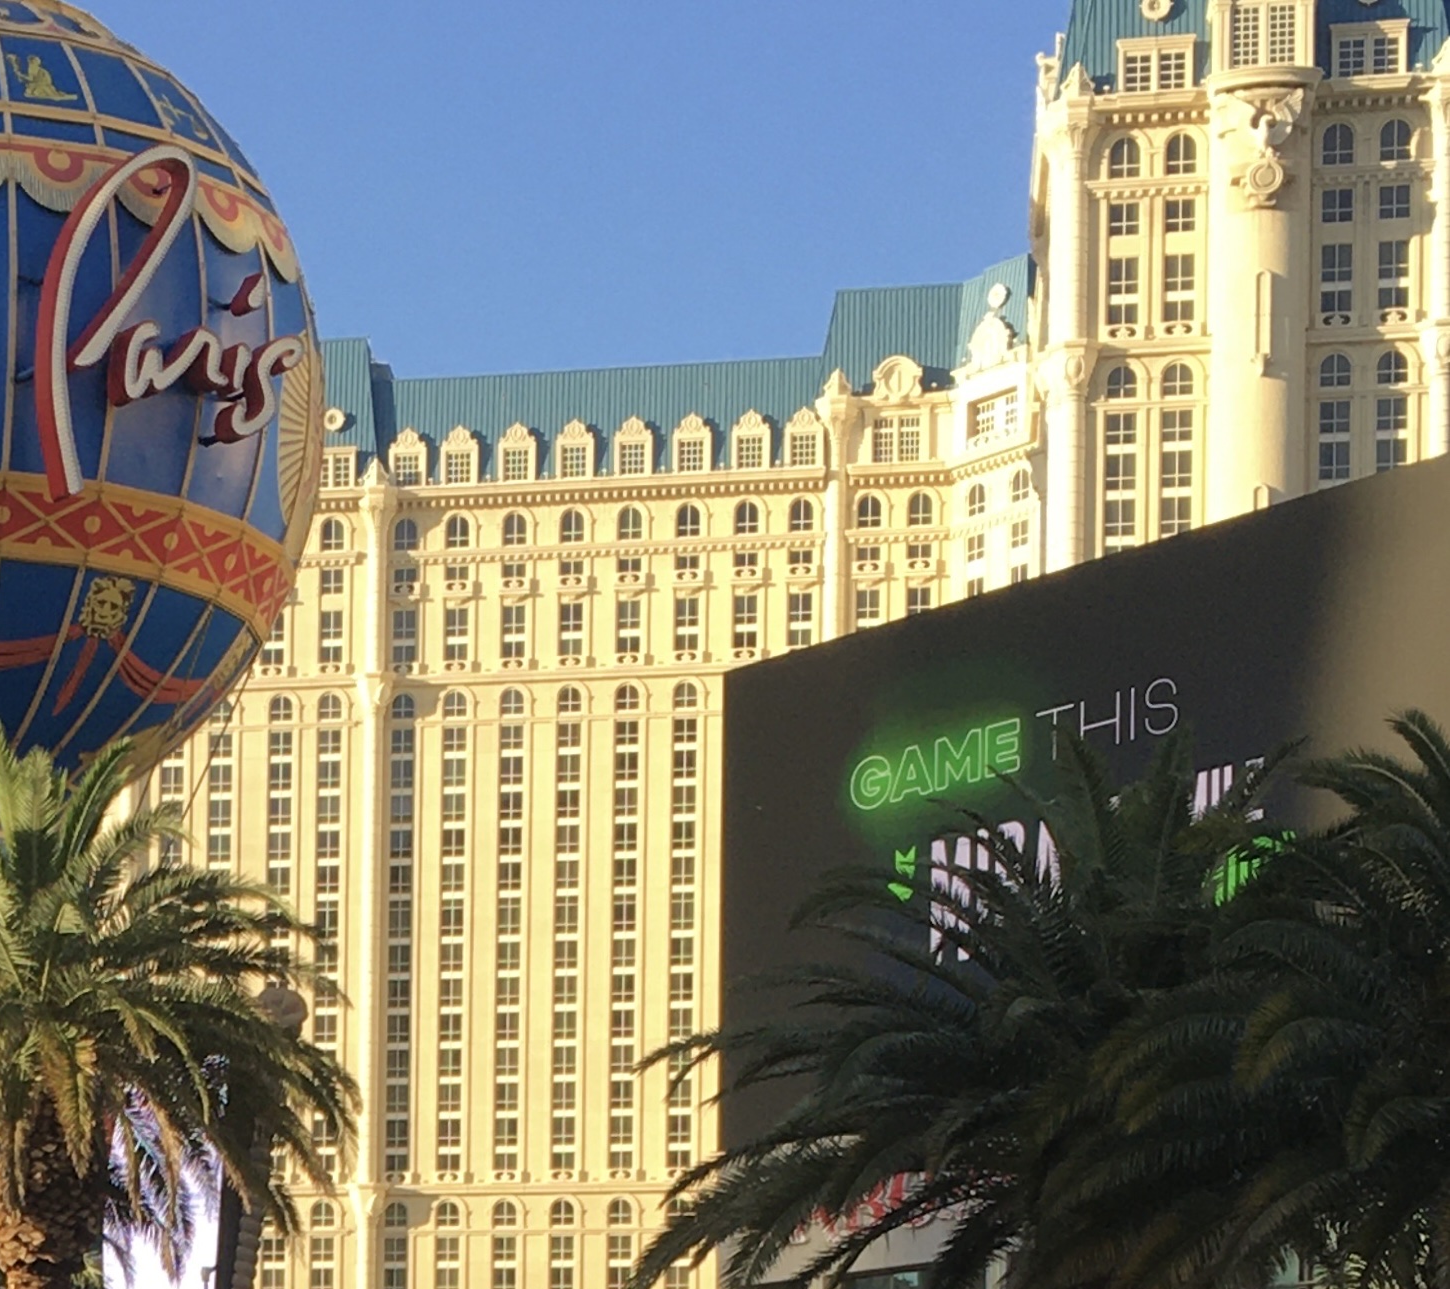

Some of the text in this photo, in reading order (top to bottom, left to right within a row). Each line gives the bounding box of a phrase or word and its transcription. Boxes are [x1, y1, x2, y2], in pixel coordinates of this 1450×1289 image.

[36, 143, 304, 502] Paris
[849, 677, 1179, 811] GAME THIS
